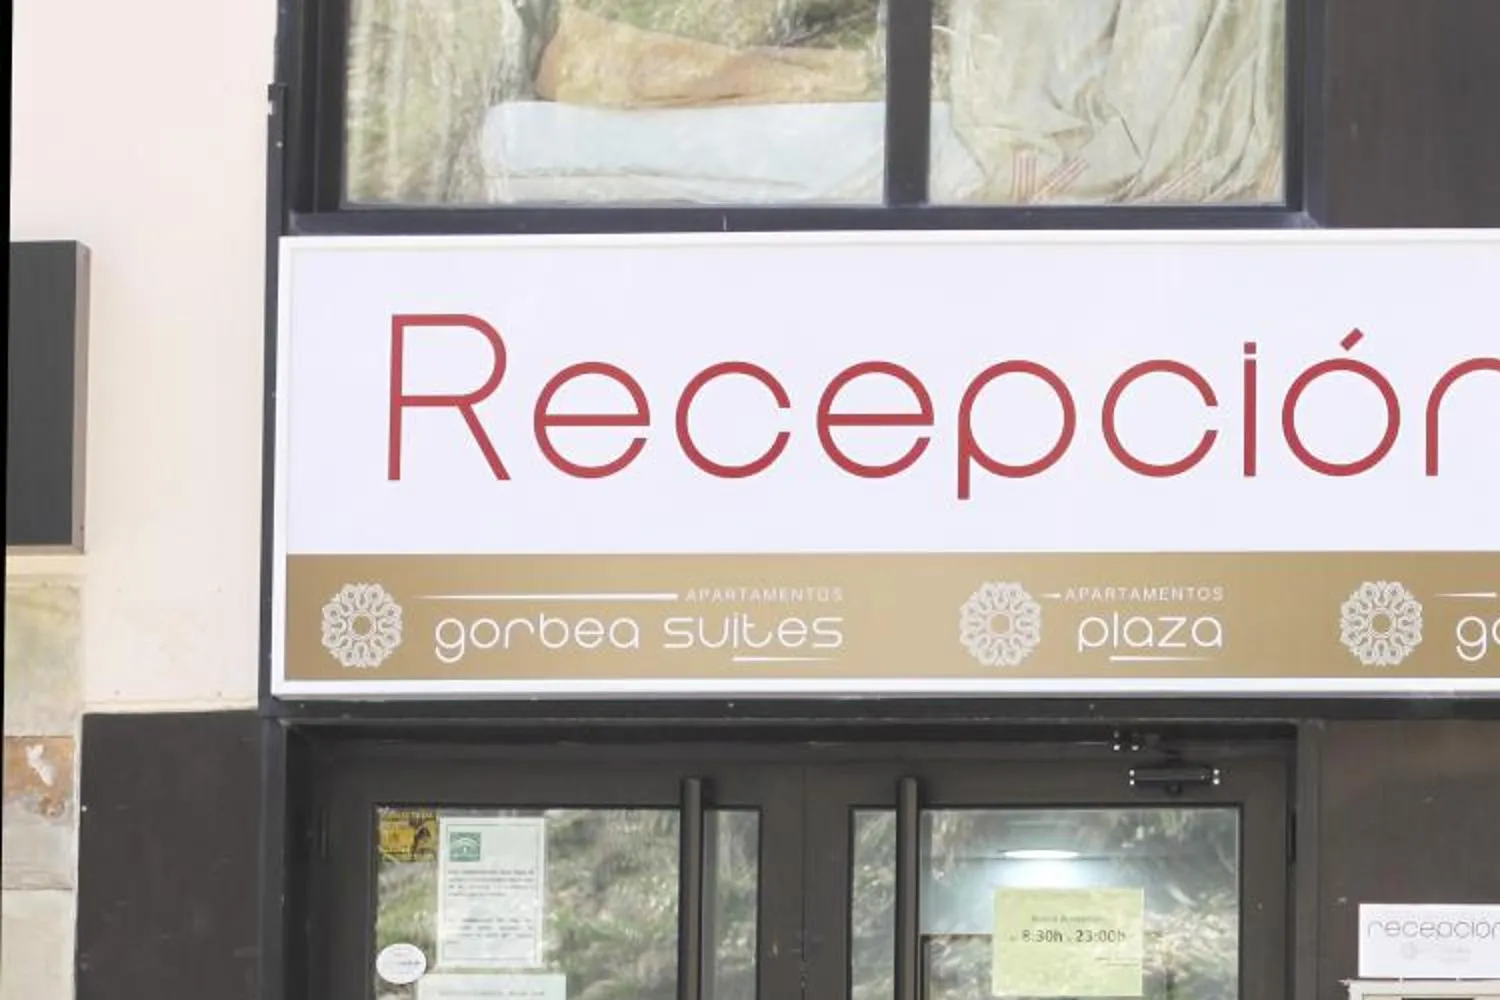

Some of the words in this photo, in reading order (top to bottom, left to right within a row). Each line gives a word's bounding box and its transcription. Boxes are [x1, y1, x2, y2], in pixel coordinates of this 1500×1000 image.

[684, 587, 844, 602] APARTAMENTOS
[1064, 586, 1225, 602] APARTAMENTOS
[435, 612, 640, 663] gorbea
[663, 611, 844, 649] suites
[1077, 611, 1224, 653] plaza
